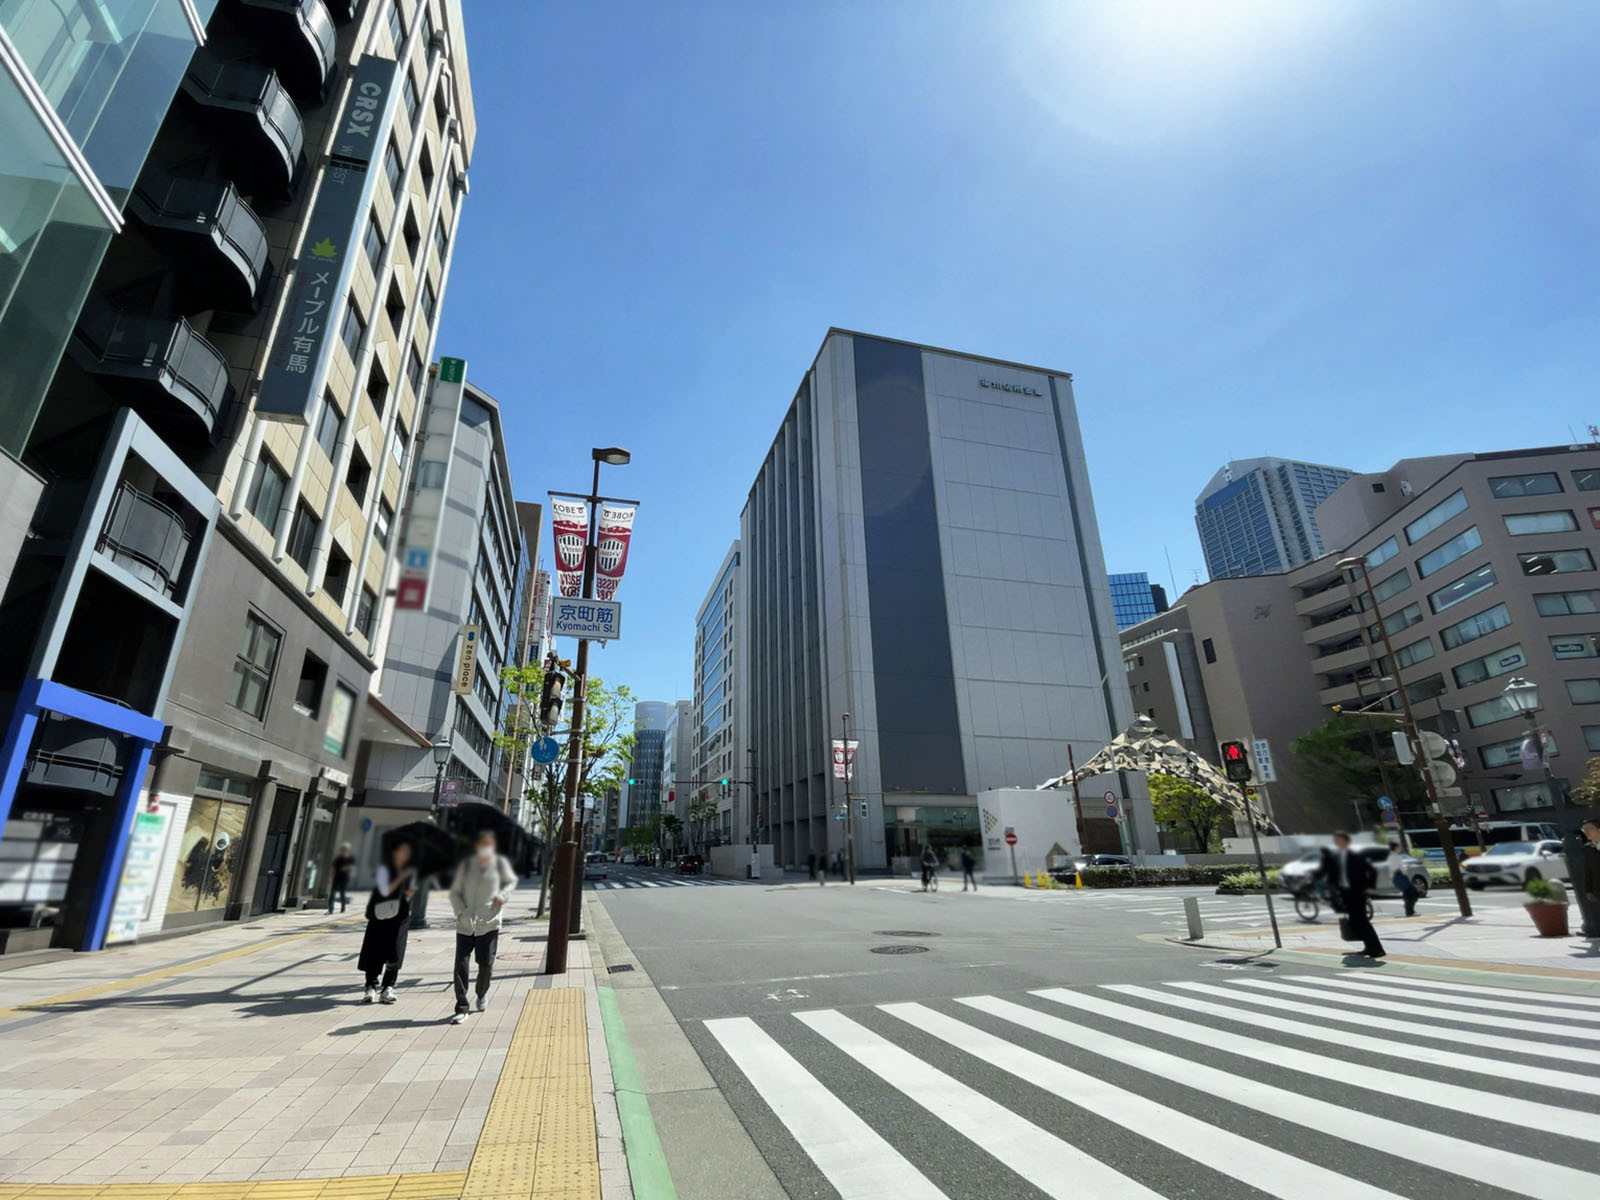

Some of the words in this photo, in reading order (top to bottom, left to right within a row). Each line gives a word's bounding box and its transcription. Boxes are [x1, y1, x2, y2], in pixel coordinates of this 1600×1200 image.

[346, 82, 381, 137] CRSX
[285, 271, 331, 374] メープル有馬
[553, 503, 576, 514] KOBE
[559, 604, 614, 624] 京町筋
[556, 620, 600, 633] Kyomachi
[603, 623, 615, 633] St.
[465, 644, 473, 661] zen
[461, 663, 472, 688] place
